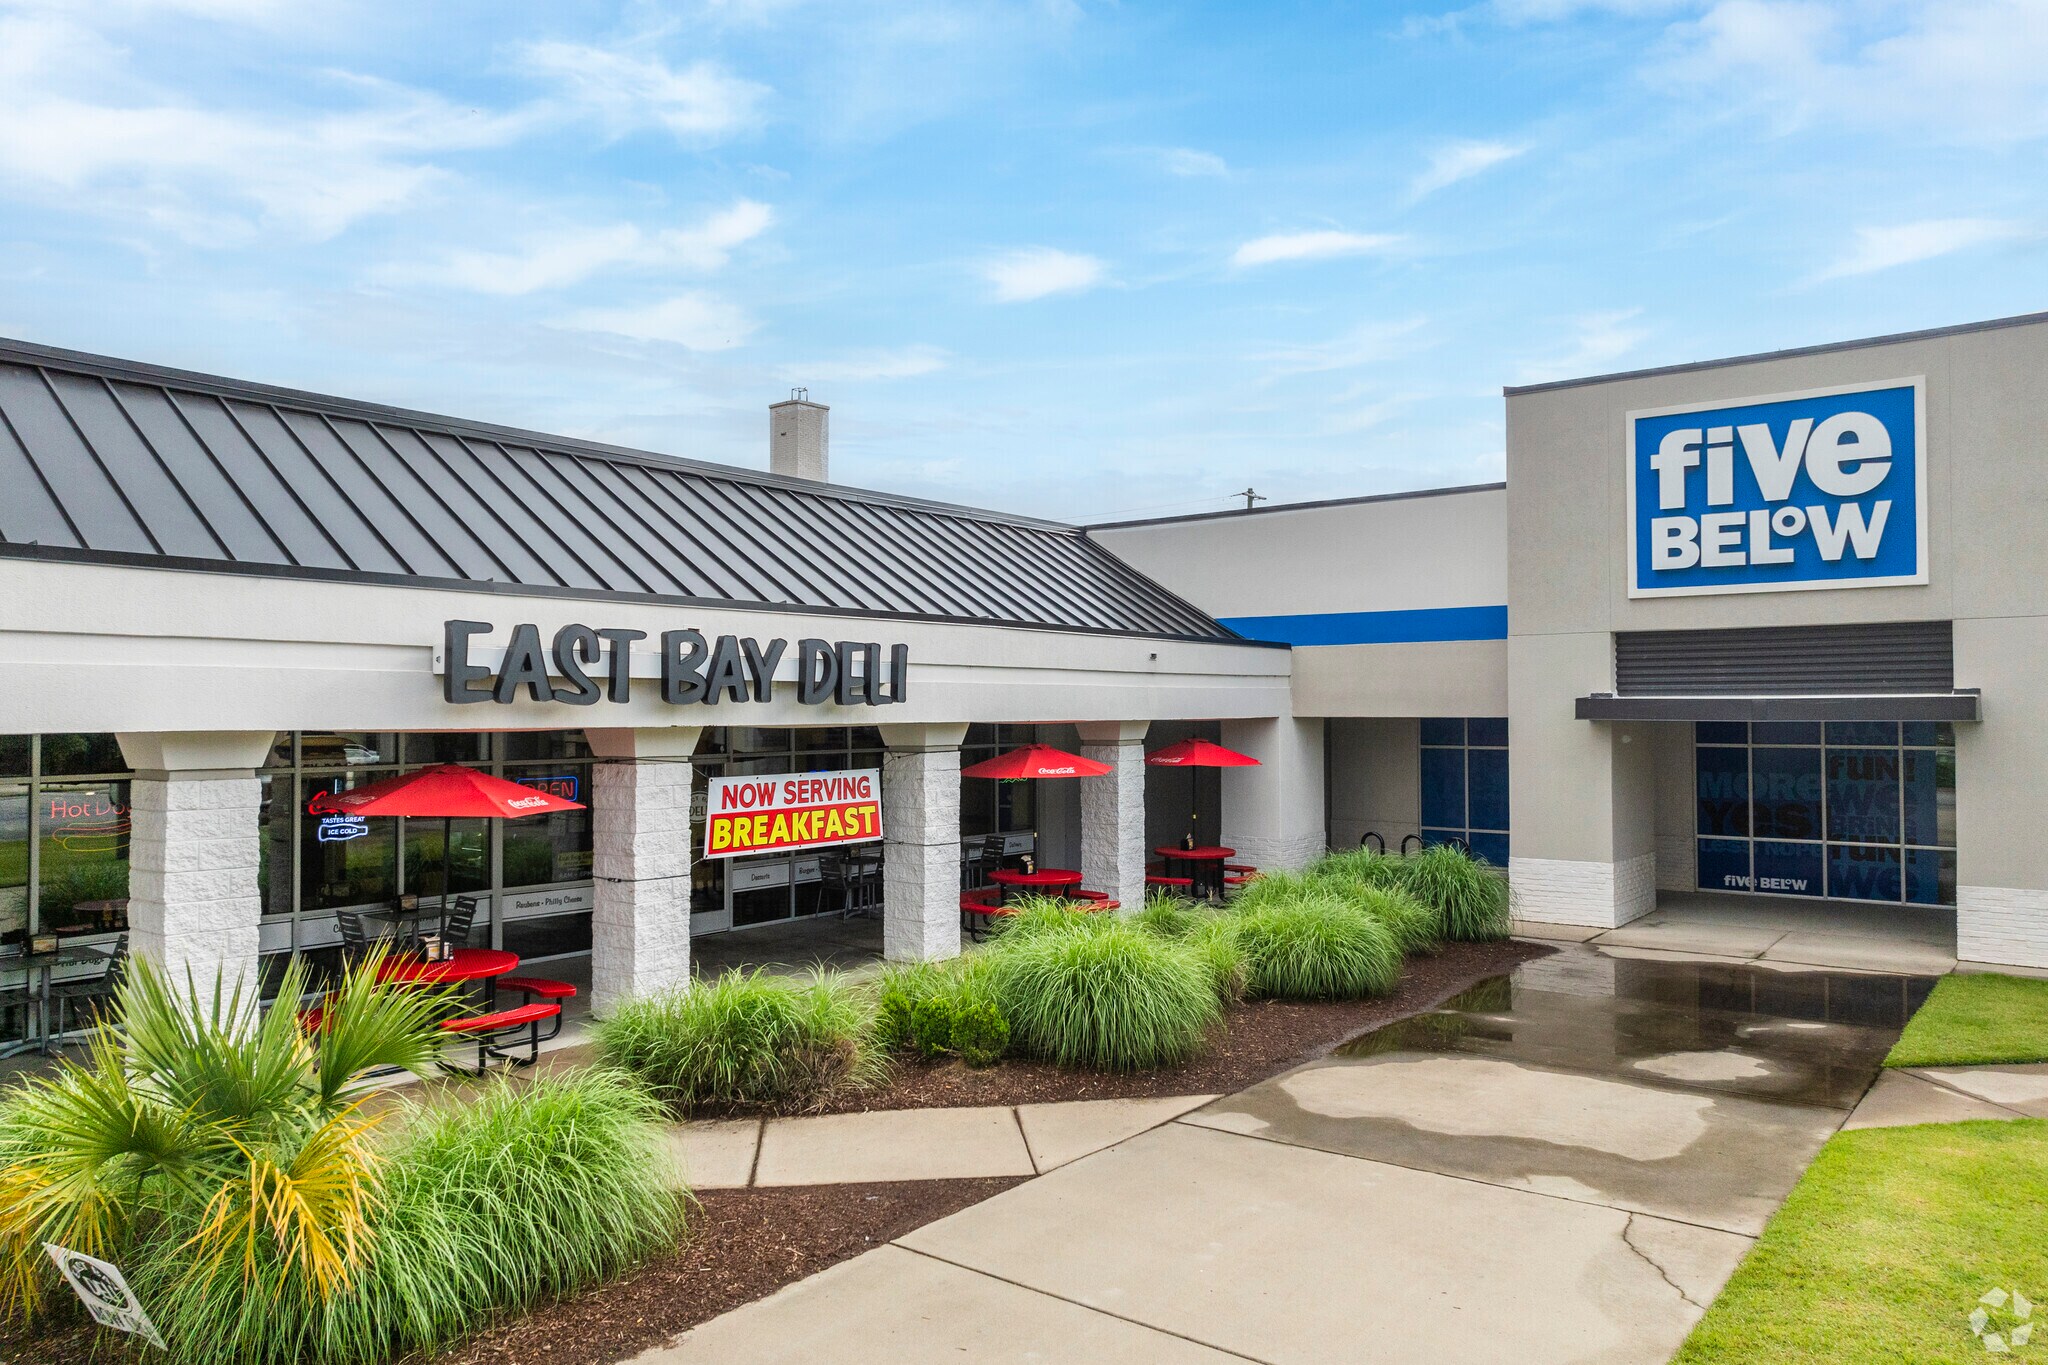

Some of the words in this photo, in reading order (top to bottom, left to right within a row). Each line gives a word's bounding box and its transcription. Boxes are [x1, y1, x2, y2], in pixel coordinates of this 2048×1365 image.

[1650, 411, 1892, 510] five
[1651, 500, 1892, 570] BELOW
[444, 619, 647, 706] EAST
[660, 630, 787, 705] BAY
[798, 638, 908, 706] DELI
[1038, 767, 1075, 775] Coca-Cola
[51, 800, 90, 819] Hot
[721, 782, 776, 810] NOW
[783, 775, 871, 805] SERVING
[712, 805, 876, 850] BREAKFAST
[1760, 877, 1807, 890] BELOW
